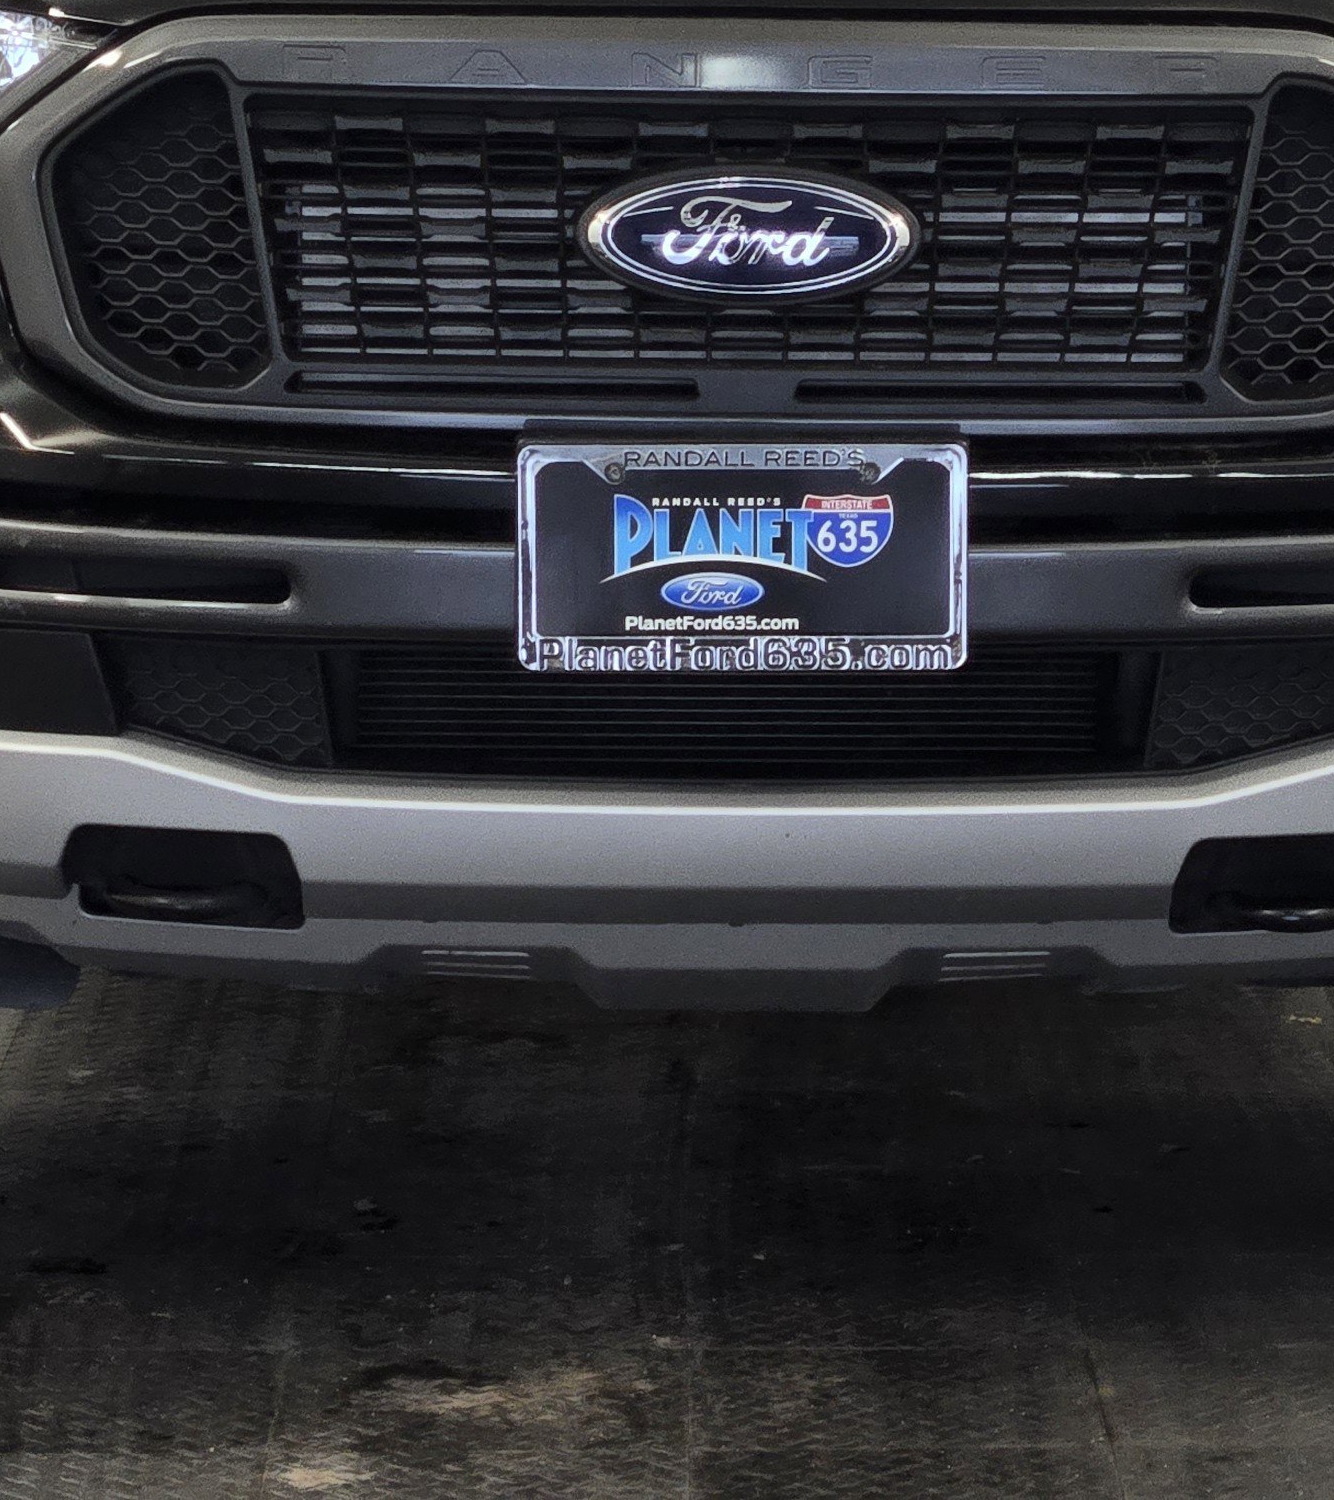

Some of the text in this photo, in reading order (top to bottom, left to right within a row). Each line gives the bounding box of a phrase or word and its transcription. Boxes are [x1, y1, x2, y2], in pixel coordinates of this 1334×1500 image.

[662, 196, 834, 266] Ford
[624, 449, 865, 467] RANDALL REED'S
[652, 498, 781, 507] RANDALL REED'S
[821, 499, 873, 509] INTERSTATE
[613, 494, 815, 576] PLANET
[817, 520, 878, 553] 635
[680, 579, 743, 606] Ford
[625, 615, 799, 632] PlanetFord635.com
[538, 636, 952, 671] PlanetFord635.com
